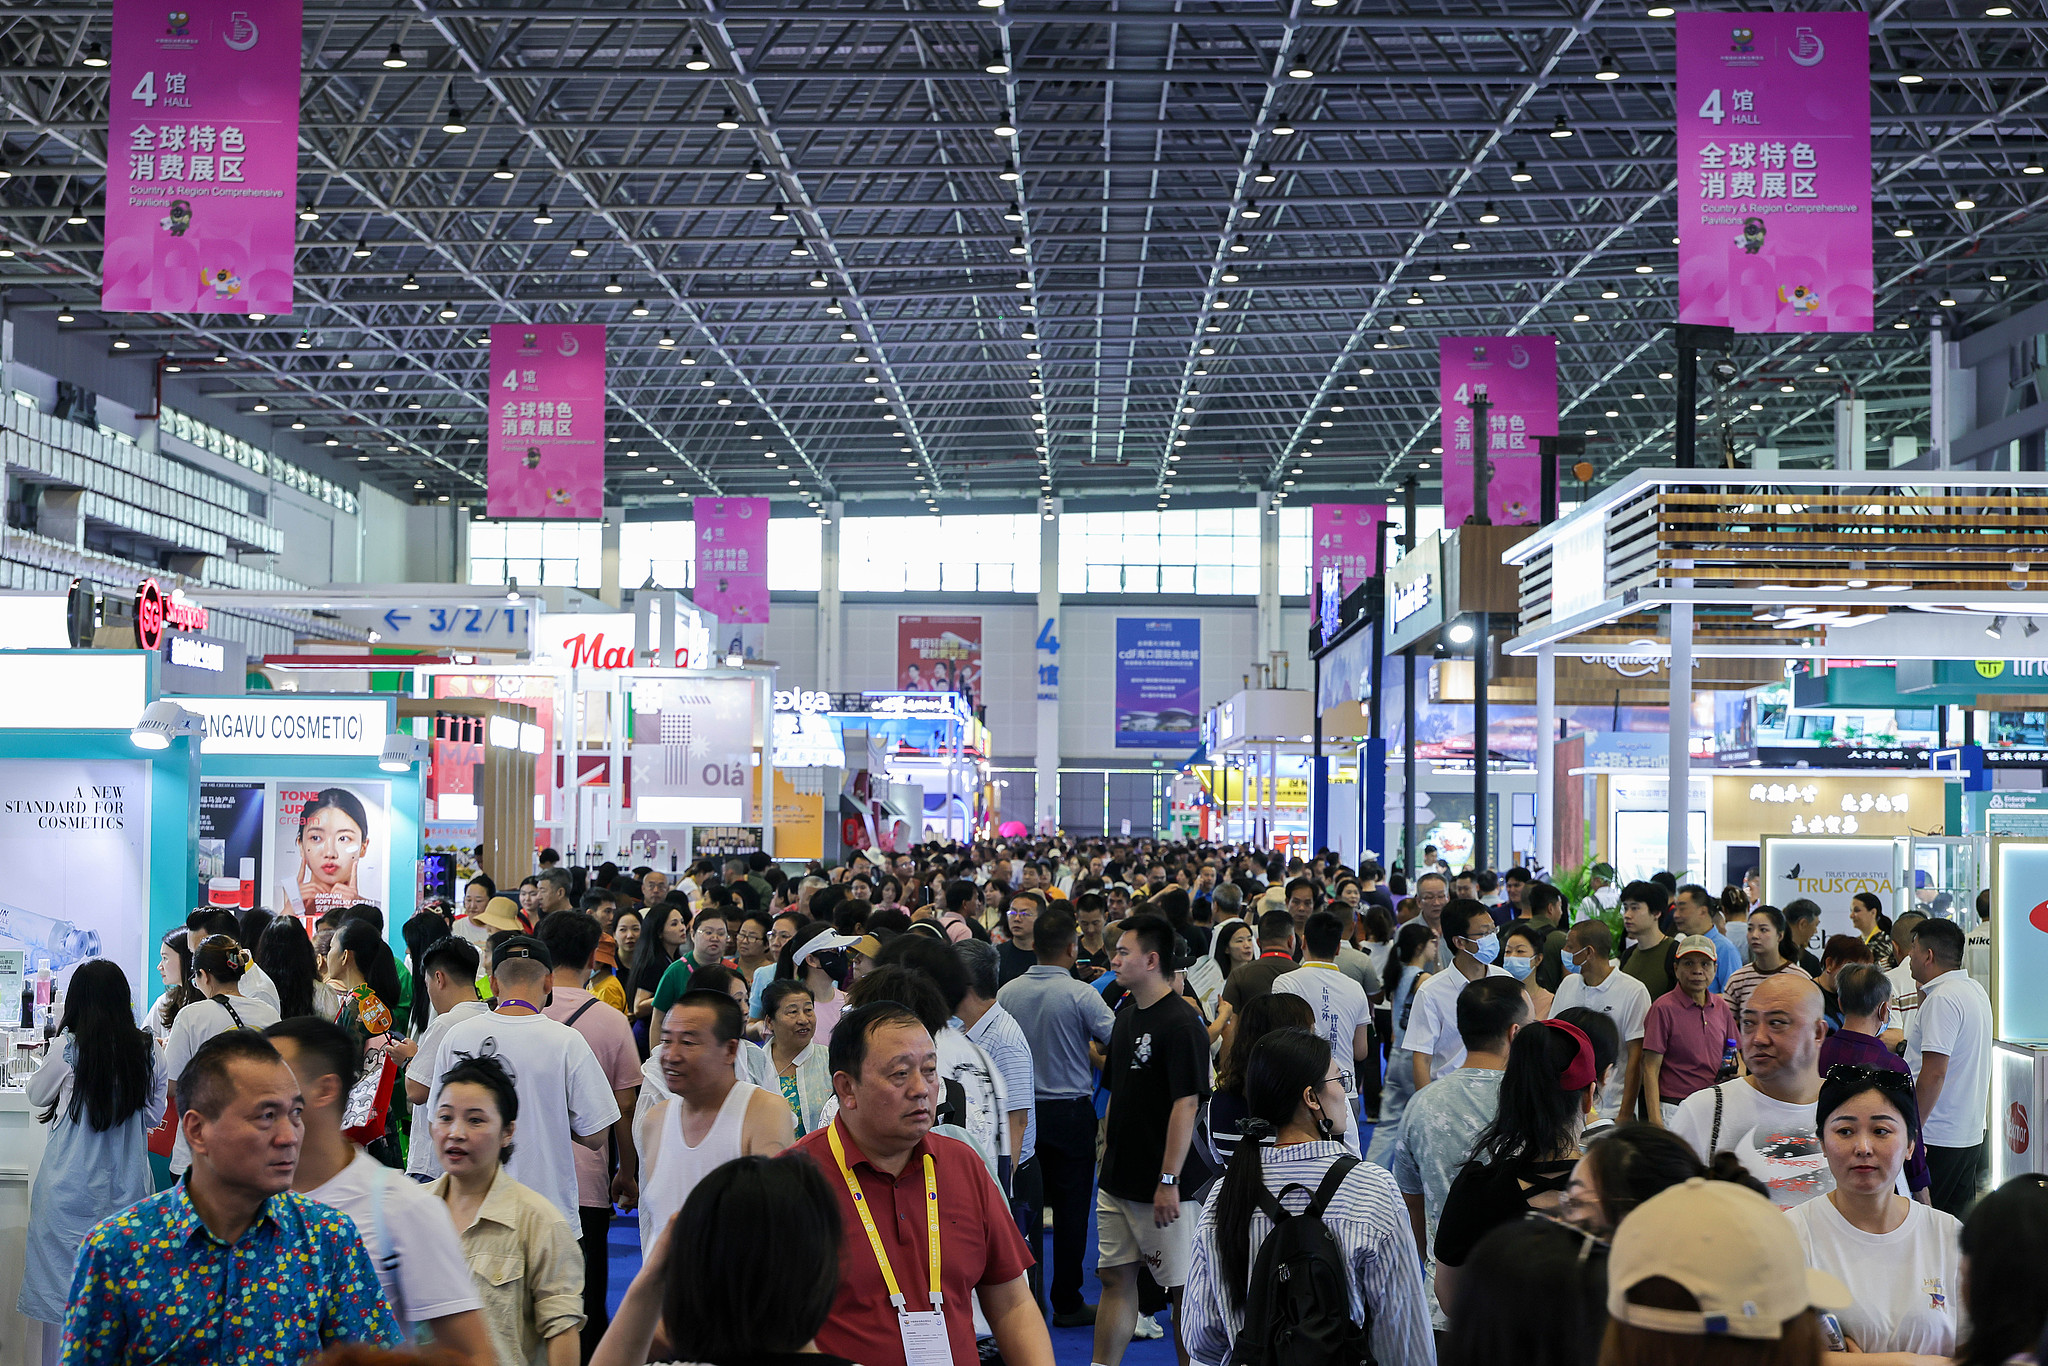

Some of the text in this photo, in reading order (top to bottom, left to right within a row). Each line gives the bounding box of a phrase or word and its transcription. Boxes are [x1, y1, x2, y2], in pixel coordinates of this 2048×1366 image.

[132, 72, 186, 106] 4 馆
[164, 98, 192, 108] HALL
[1698, 89, 1754, 124] 4 馆
[1732, 114, 1760, 124] HALL
[130, 124, 246, 152] 全球特色
[1699, 142, 1818, 170] 全球特色
[129, 154, 246, 182] 消费展区
[129, 186, 284, 199] Country & Region Comprehensive
[1699, 172, 1818, 200] 消费展区
[1701, 203, 1858, 215] Country & Region Comprehensive
[502, 370, 536, 392] 4 馆
[1454, 383, 1470, 406] 4
[502, 402, 573, 418] 全球特色
[502, 420, 573, 437] 消费展区
[1454, 415, 1526, 432] 全特色
[1454, 433, 1526, 450] 消展区
[702, 527, 714, 542] 4
[1320, 534, 1330, 548] 4
[144, 598, 159, 634] SG
[429, 608, 529, 634] 3/2/1
[1036, 618, 1060, 654] 4
[702, 762, 745, 786] Olá
[74, 786, 126, 798] A NEW
[280, 790, 320, 802] TONE
[5, 800, 124, 814] STANDARD FOR
[280, 804, 305, 814] -UP
[38, 816, 124, 830] COSMETICS
[280, 816, 320, 826] cream
[1794, 878, 1894, 894] TRUSCADA
